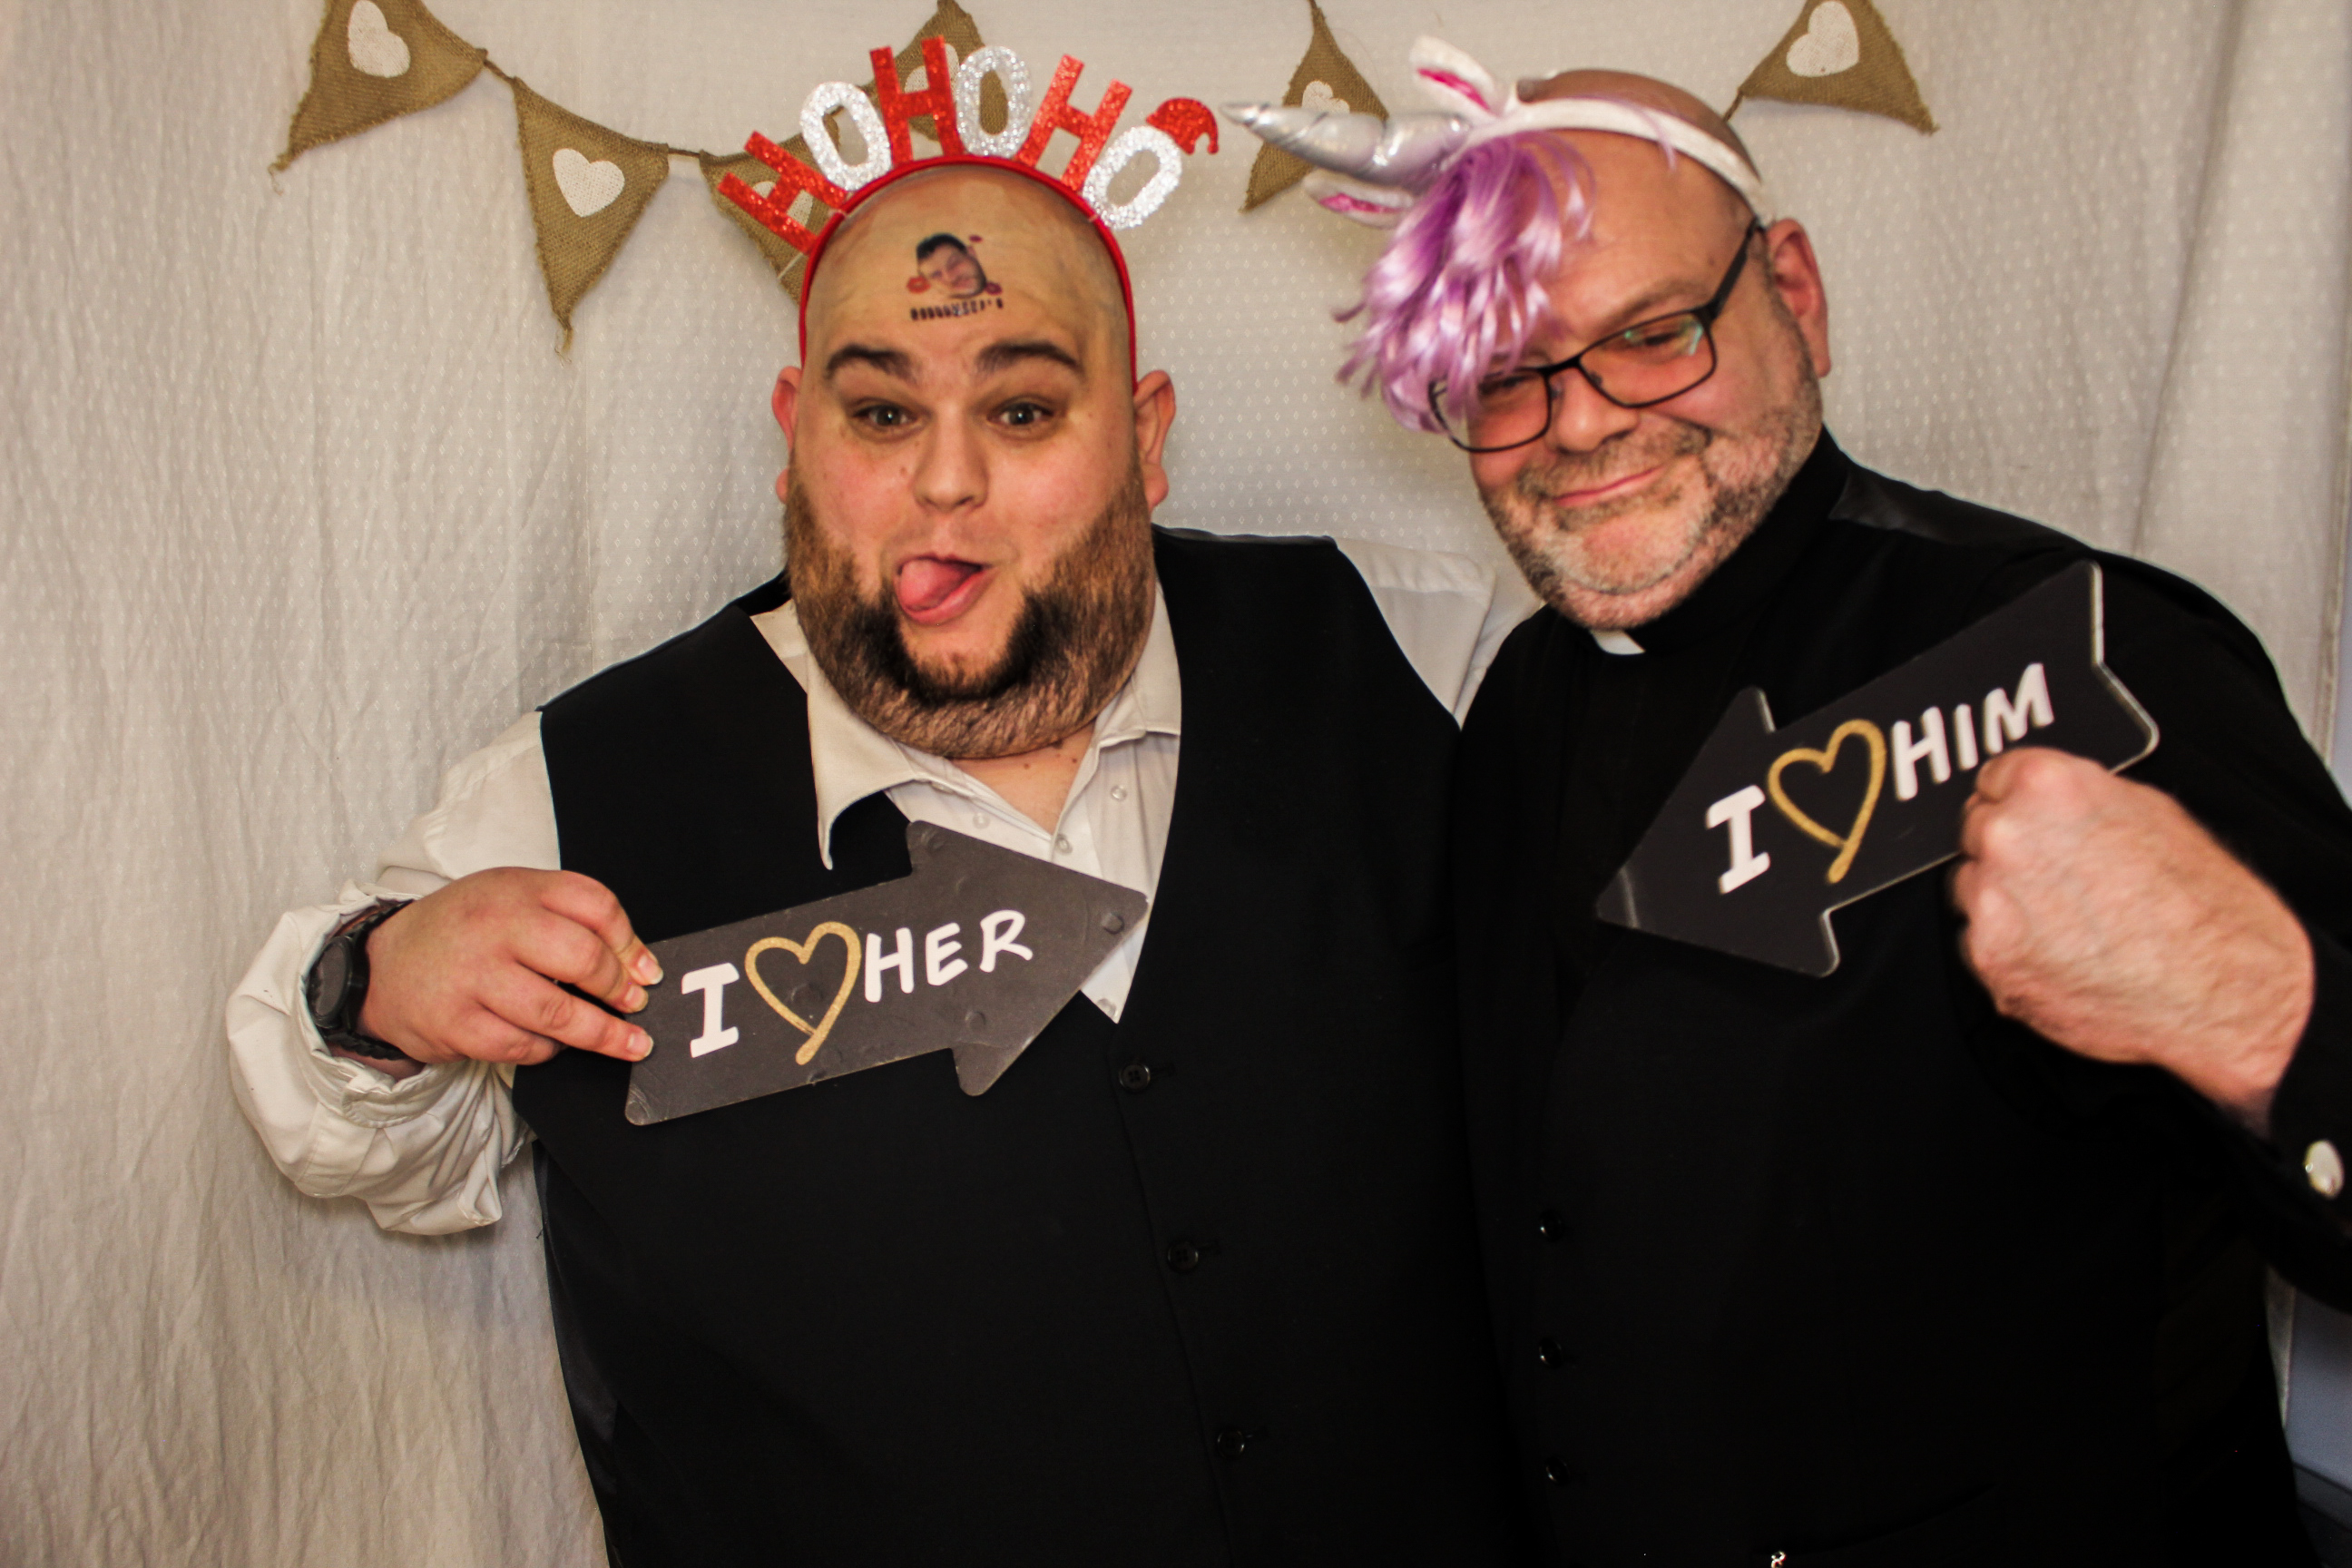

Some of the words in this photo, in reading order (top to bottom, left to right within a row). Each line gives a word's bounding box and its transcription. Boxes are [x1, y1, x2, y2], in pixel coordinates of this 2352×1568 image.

[1705, 785, 1770, 894] I
[1891, 662, 2054, 801] HIM
[681, 963, 740, 1058] I
[865, 910, 1033, 1003] HER
